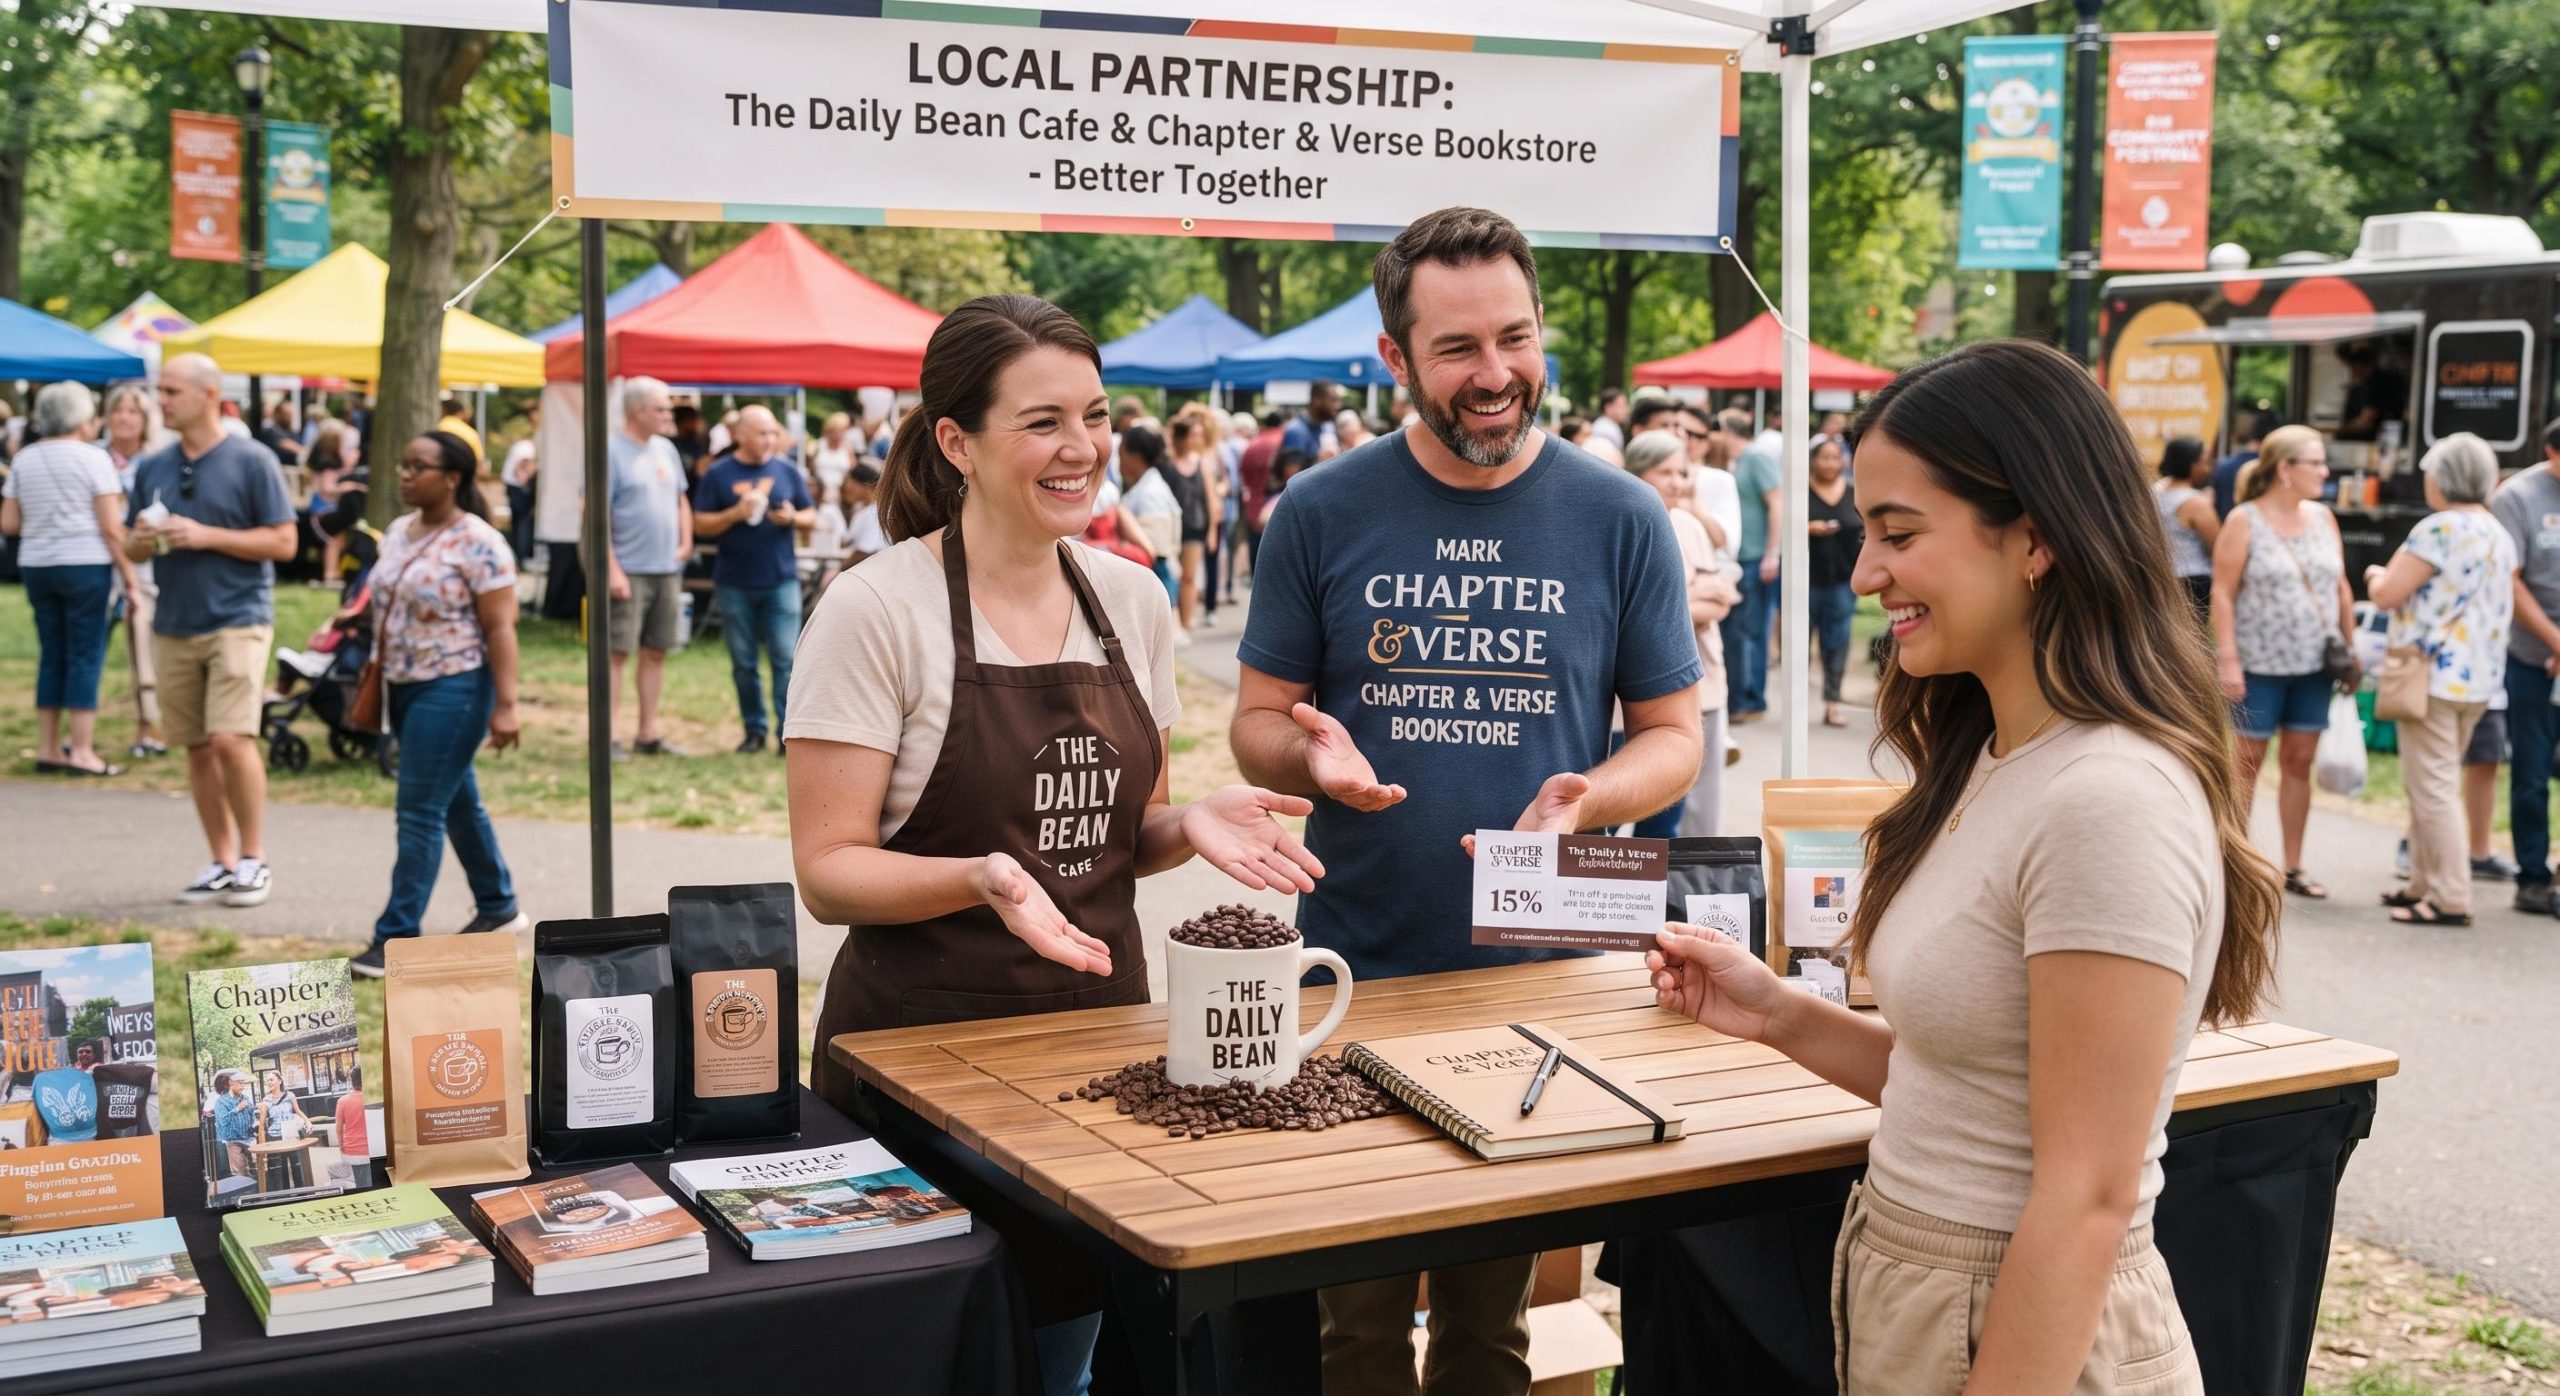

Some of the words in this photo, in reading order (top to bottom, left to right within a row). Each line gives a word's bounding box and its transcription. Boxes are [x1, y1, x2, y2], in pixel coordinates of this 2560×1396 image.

[909, 42, 1074, 91] LOCAL
[1091, 52, 1454, 110] PARTNERSHIP:
[725, 93, 796, 128] The
[809, 97, 901, 141] Daily
[915, 102, 1006, 138] Bean
[1018, 107, 1099, 141] Cafe
[1111, 112, 1136, 144] &
[1147, 114, 1286, 156] Chapter
[1296, 121, 1320, 153] &
[1330, 123, 1424, 157] Verse
[1434, 128, 1597, 163] Bookstore
[1054, 159, 1165, 194] Better
[1175, 163, 1328, 204] Together
[1435, 538, 1503, 563] MARK
[1364, 574, 1566, 614] CHAPTER
[1361, 682, 1455, 709] CHAPTER
[1463, 687, 1480, 711] &
[1489, 688, 1557, 715] VERSE
[1391, 716, 1520, 746] BOOKSTORE
[1055, 736, 1099, 765] THE
[1034, 768, 1121, 812] DAILY
[1038, 812, 1111, 852] BEAN
[1058, 858, 1093, 877] CAFE
[1505, 856, 1542, 868] VERSE
[1567, 846, 1586, 856] The
[1588, 847, 1616, 859] Daily
[213, 980, 329, 1010] Chapter
[1226, 980, 1266, 1003] THE
[231, 1014, 253, 1038] &
[258, 1009, 336, 1035] Verse
[1206, 1003, 1284, 1038] DAILY
[1213, 1040, 1276, 1069] BEAN
